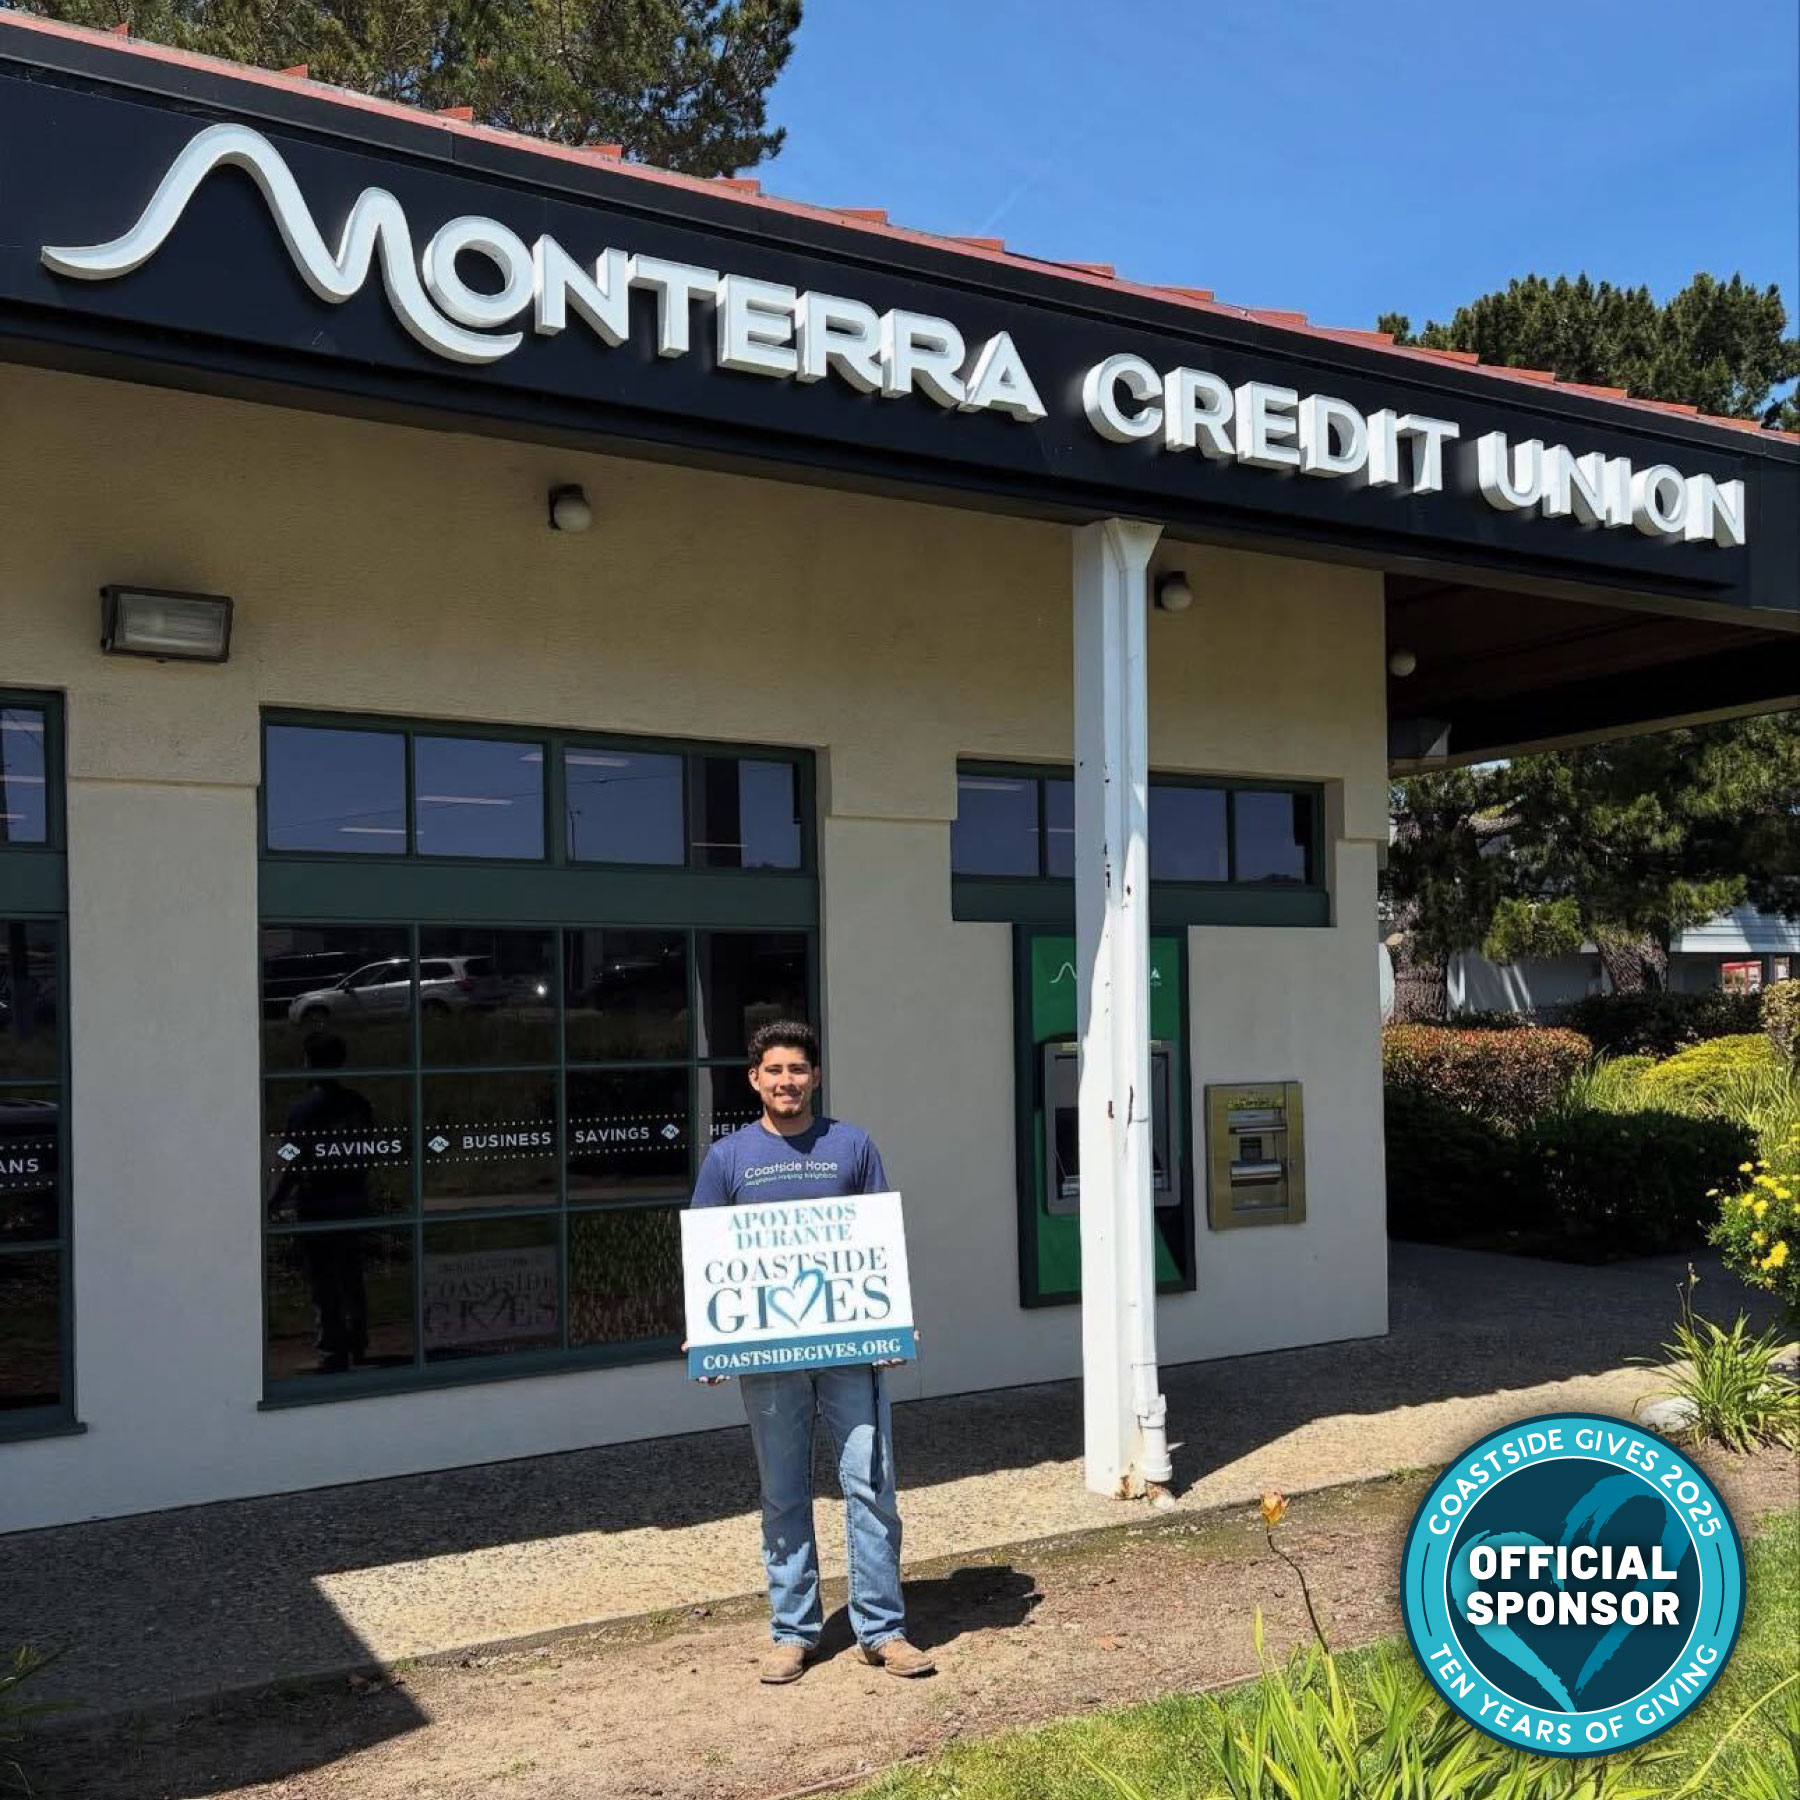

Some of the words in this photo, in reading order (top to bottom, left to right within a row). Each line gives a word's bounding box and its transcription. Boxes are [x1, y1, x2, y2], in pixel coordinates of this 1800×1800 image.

[41, 122, 1047, 422] MONTERRA
[1083, 353, 1460, 494] CREDIT
[1478, 430, 1745, 547] UNION
[315, 1138, 402, 1157] SAVINGS
[462, 1131, 552, 1150] BUSINESS
[575, 1127, 650, 1144] SAVINGS
[744, 1160, 802, 1179] Coastside
[806, 1160, 838, 1172] Hope
[729, 1203, 856, 1231] APOYENOS
[737, 1223, 852, 1250] DURANTE
[705, 1246, 887, 1285] COASTSIDE
[703, 1338, 901, 1370] COASTSIDEGIVES.ORG
